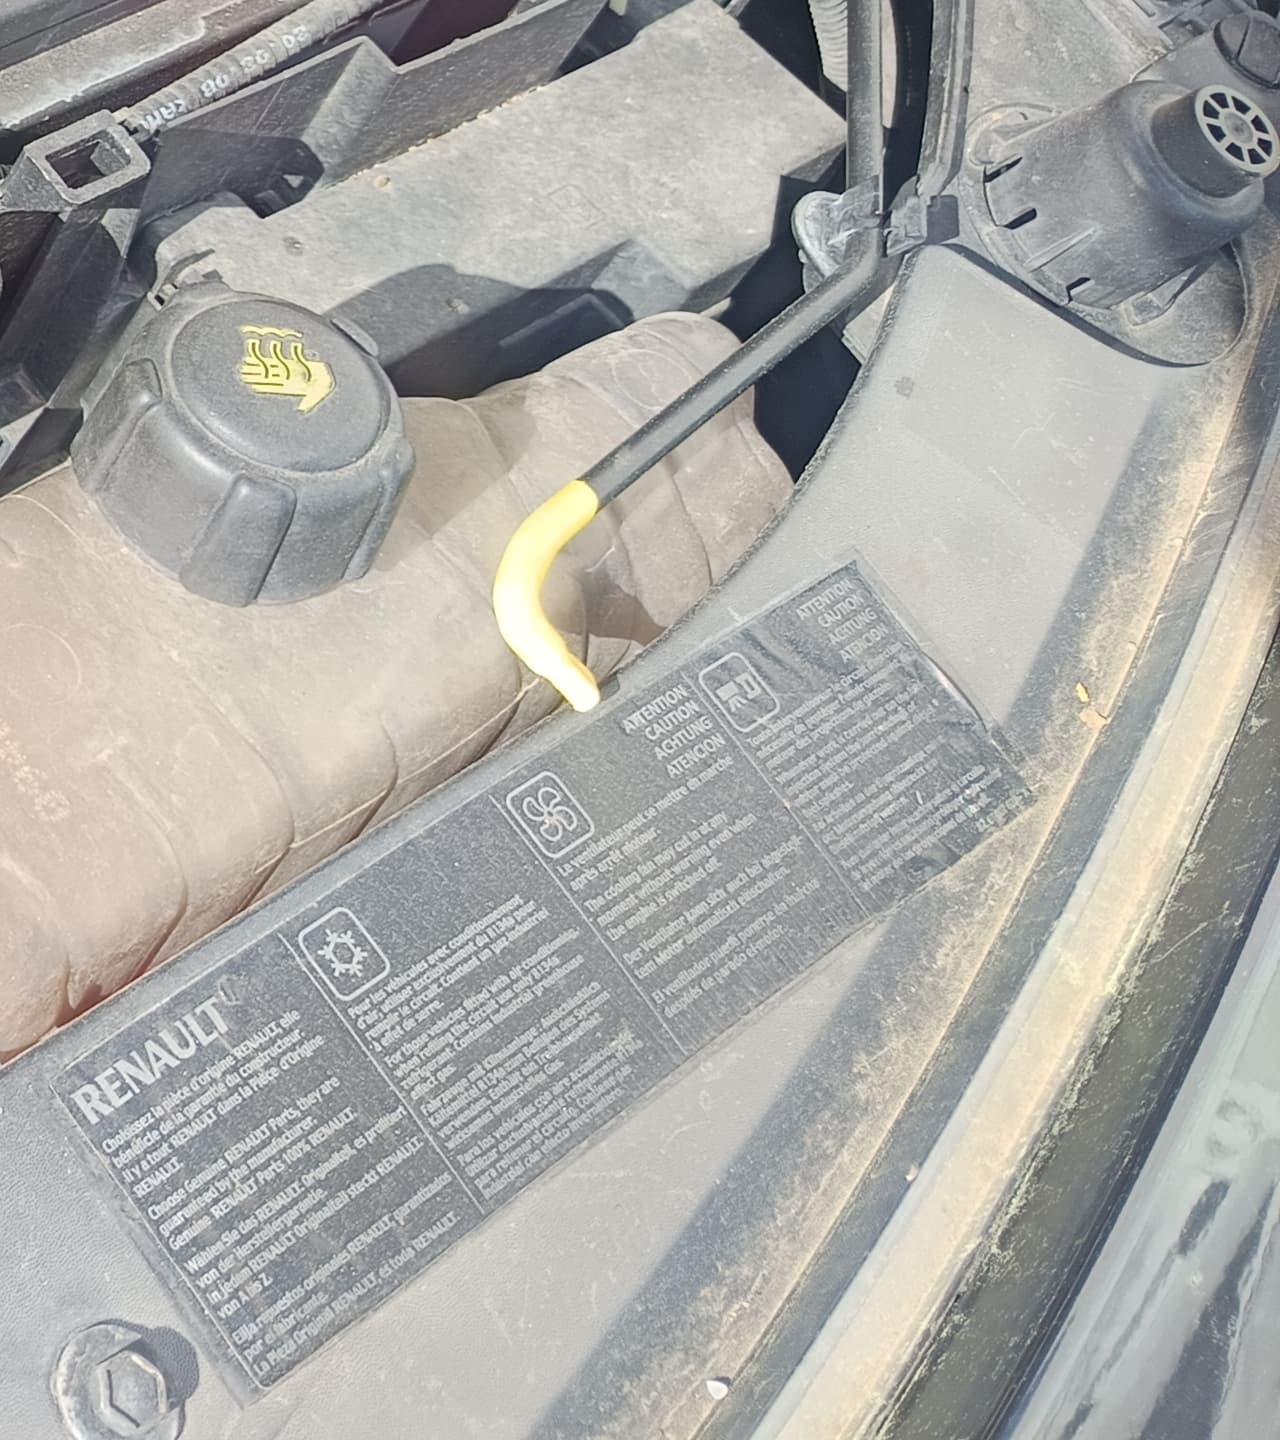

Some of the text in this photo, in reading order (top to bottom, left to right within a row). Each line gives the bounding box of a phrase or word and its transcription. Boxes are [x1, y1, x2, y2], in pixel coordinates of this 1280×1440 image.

[796, 576, 854, 620] ATTENTION
[817, 590, 864, 627] CAUTION
[622, 684, 688, 733] ATTENTION
[644, 700, 700, 739] CAUTION
[654, 715, 712, 760] ACHTUNG
[666, 733, 725, 777] ATENCION
[70, 996, 229, 1125] RENAULT
[102, 1112, 154, 1152] Choisissez
[150, 1105, 164, 1118] la
[159, 1086, 192, 1112] pièce
[189, 1055, 239, 1090] d'origine
[279, 1010, 300, 1027] elle
[146, 1142, 172, 1164] tout
[169, 1108, 216, 1147] RENAULT
[217, 1092, 242, 1114] dans
[238, 1085, 253, 1098] la
[279, 1035, 326, 1069] d'Origine
[159, 1119, 174, 1134] de
[170, 1112, 186, 1124] la
[183, 1079, 228, 1119] garantie
[225, 1072, 241, 1087] du
[238, 1026, 305, 1076] constructeur.
[133, 1156, 184, 1197] RENAULT.
[147, 1188, 186, 1219] Choose
[184, 1158, 227, 1192] Genuine
[224, 1123, 269, 1163] RENAULT
[295, 1088, 322, 1110] they
[319, 1076, 340, 1094] are
[159, 1116, 317, 1237] guaranteed by the manufacturer.
[169, 1105, 358, 1250] Genuine RENAULT Parts 100% RENAULT.
[183, 1241, 225, 1273] Wählen
[220, 1229, 240, 1246] Sie
[234, 1212, 258, 1234] das
[353, 1135, 367, 1148] es
[206, 1290, 221, 1304] In
[218, 1266, 254, 1298] jedem
[248, 1230, 295, 1272] RENAULT
[346, 1169, 379, 1198] steckt
[195, 1268, 219, 1288] von
[218, 1253, 235, 1273] der
[217, 1298, 240, 1318] von
[238, 1290, 250, 1304] A
[252, 1360, 270, 1377] La
[293, 1306, 339, 1344] Original
[378, 1263, 393, 1278] es
[388, 1246, 415, 1269] toda
